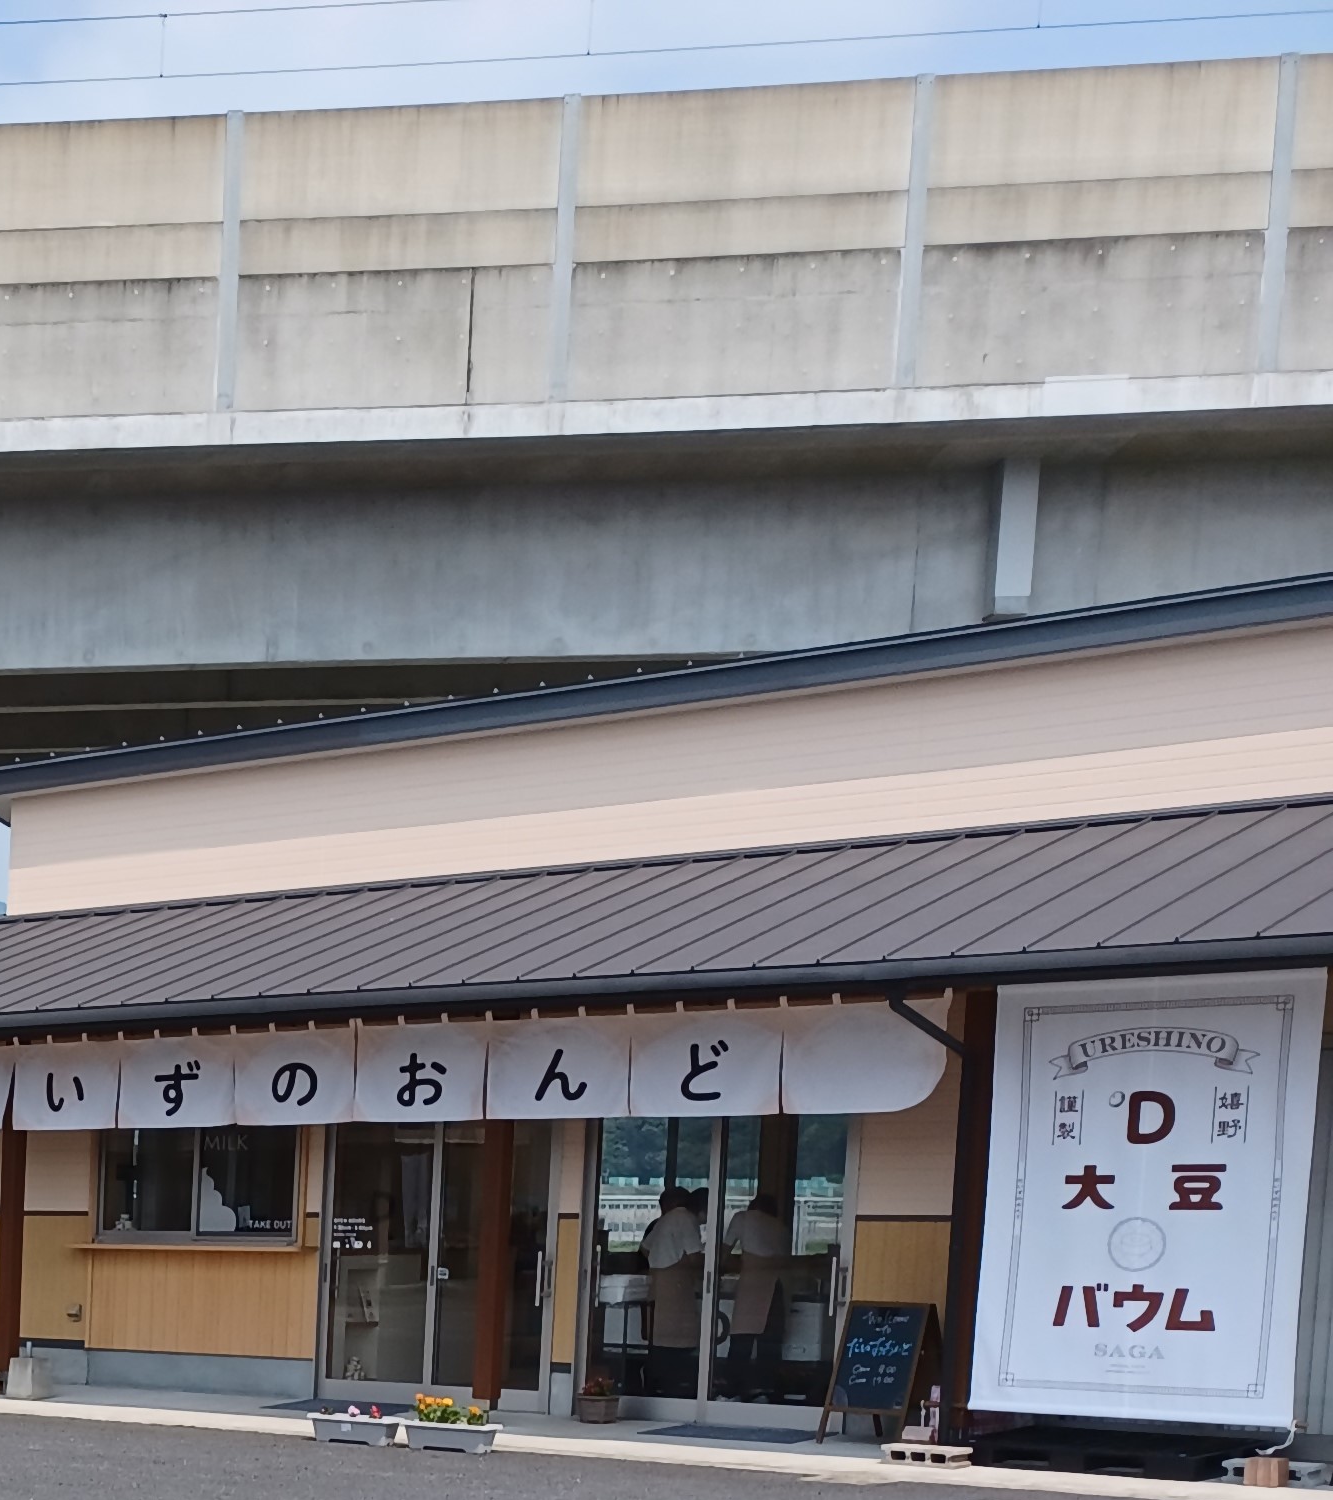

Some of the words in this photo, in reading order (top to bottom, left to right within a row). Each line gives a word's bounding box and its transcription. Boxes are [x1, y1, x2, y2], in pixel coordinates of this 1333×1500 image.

[1079, 1031, 1226, 1057] URESHINO
[1127, 1091, 1175, 1144] D
[1217, 1092, 1244, 1138] 嬉野
[204, 1135, 249, 1151] MILK
[248, 1220, 271, 1229] TAKE
[274, 1220, 292, 1229] OUT
[1053, 1283, 1215, 1332] バウム
[1093, 1343, 1165, 1359] SAGA
